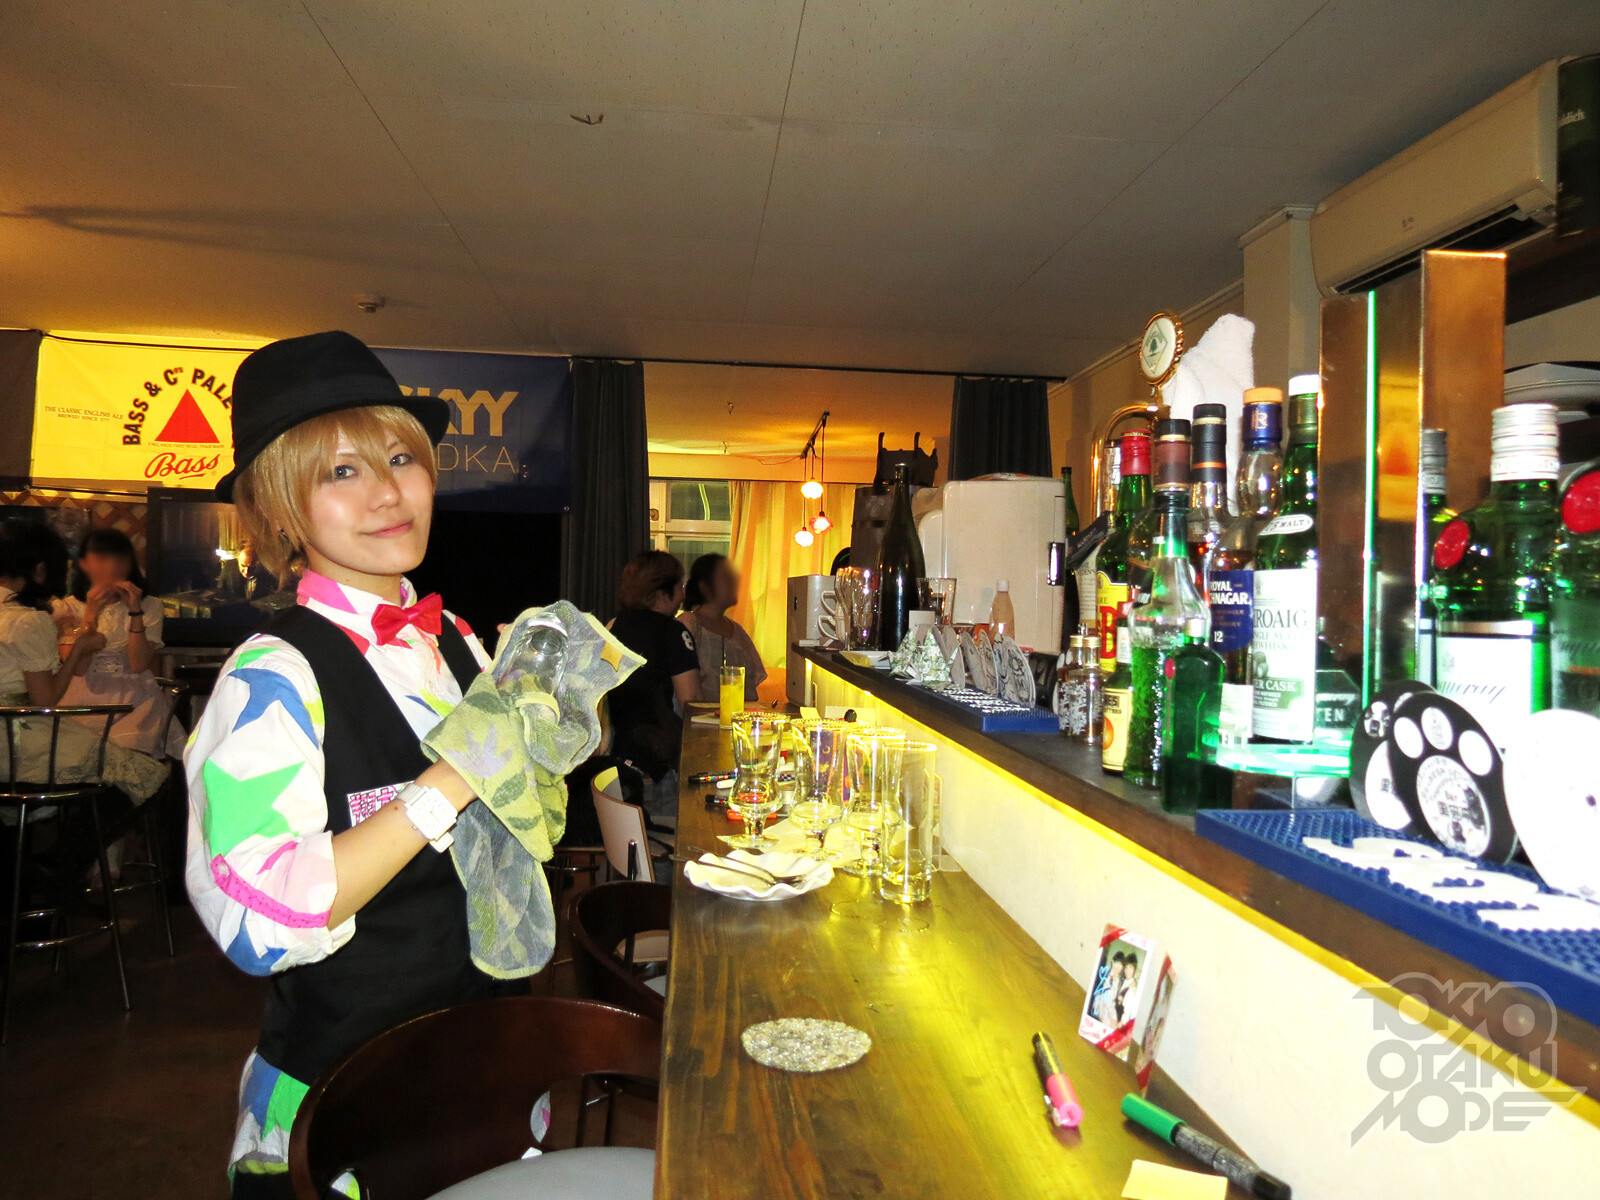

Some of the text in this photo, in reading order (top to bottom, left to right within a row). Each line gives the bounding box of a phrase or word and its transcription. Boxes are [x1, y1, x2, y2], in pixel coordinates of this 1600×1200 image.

[57, 407, 82, 415] CLASSIC
[84, 409, 111, 417] ENGLISH
[122, 398, 149, 446] BASS
[144, 382, 162, 397] &
[144, 452, 221, 480] Bass
[437, 443, 516, 473] DKA
[1213, 630, 1224, 643] 12
[1265, 679, 1297, 693] CASK
